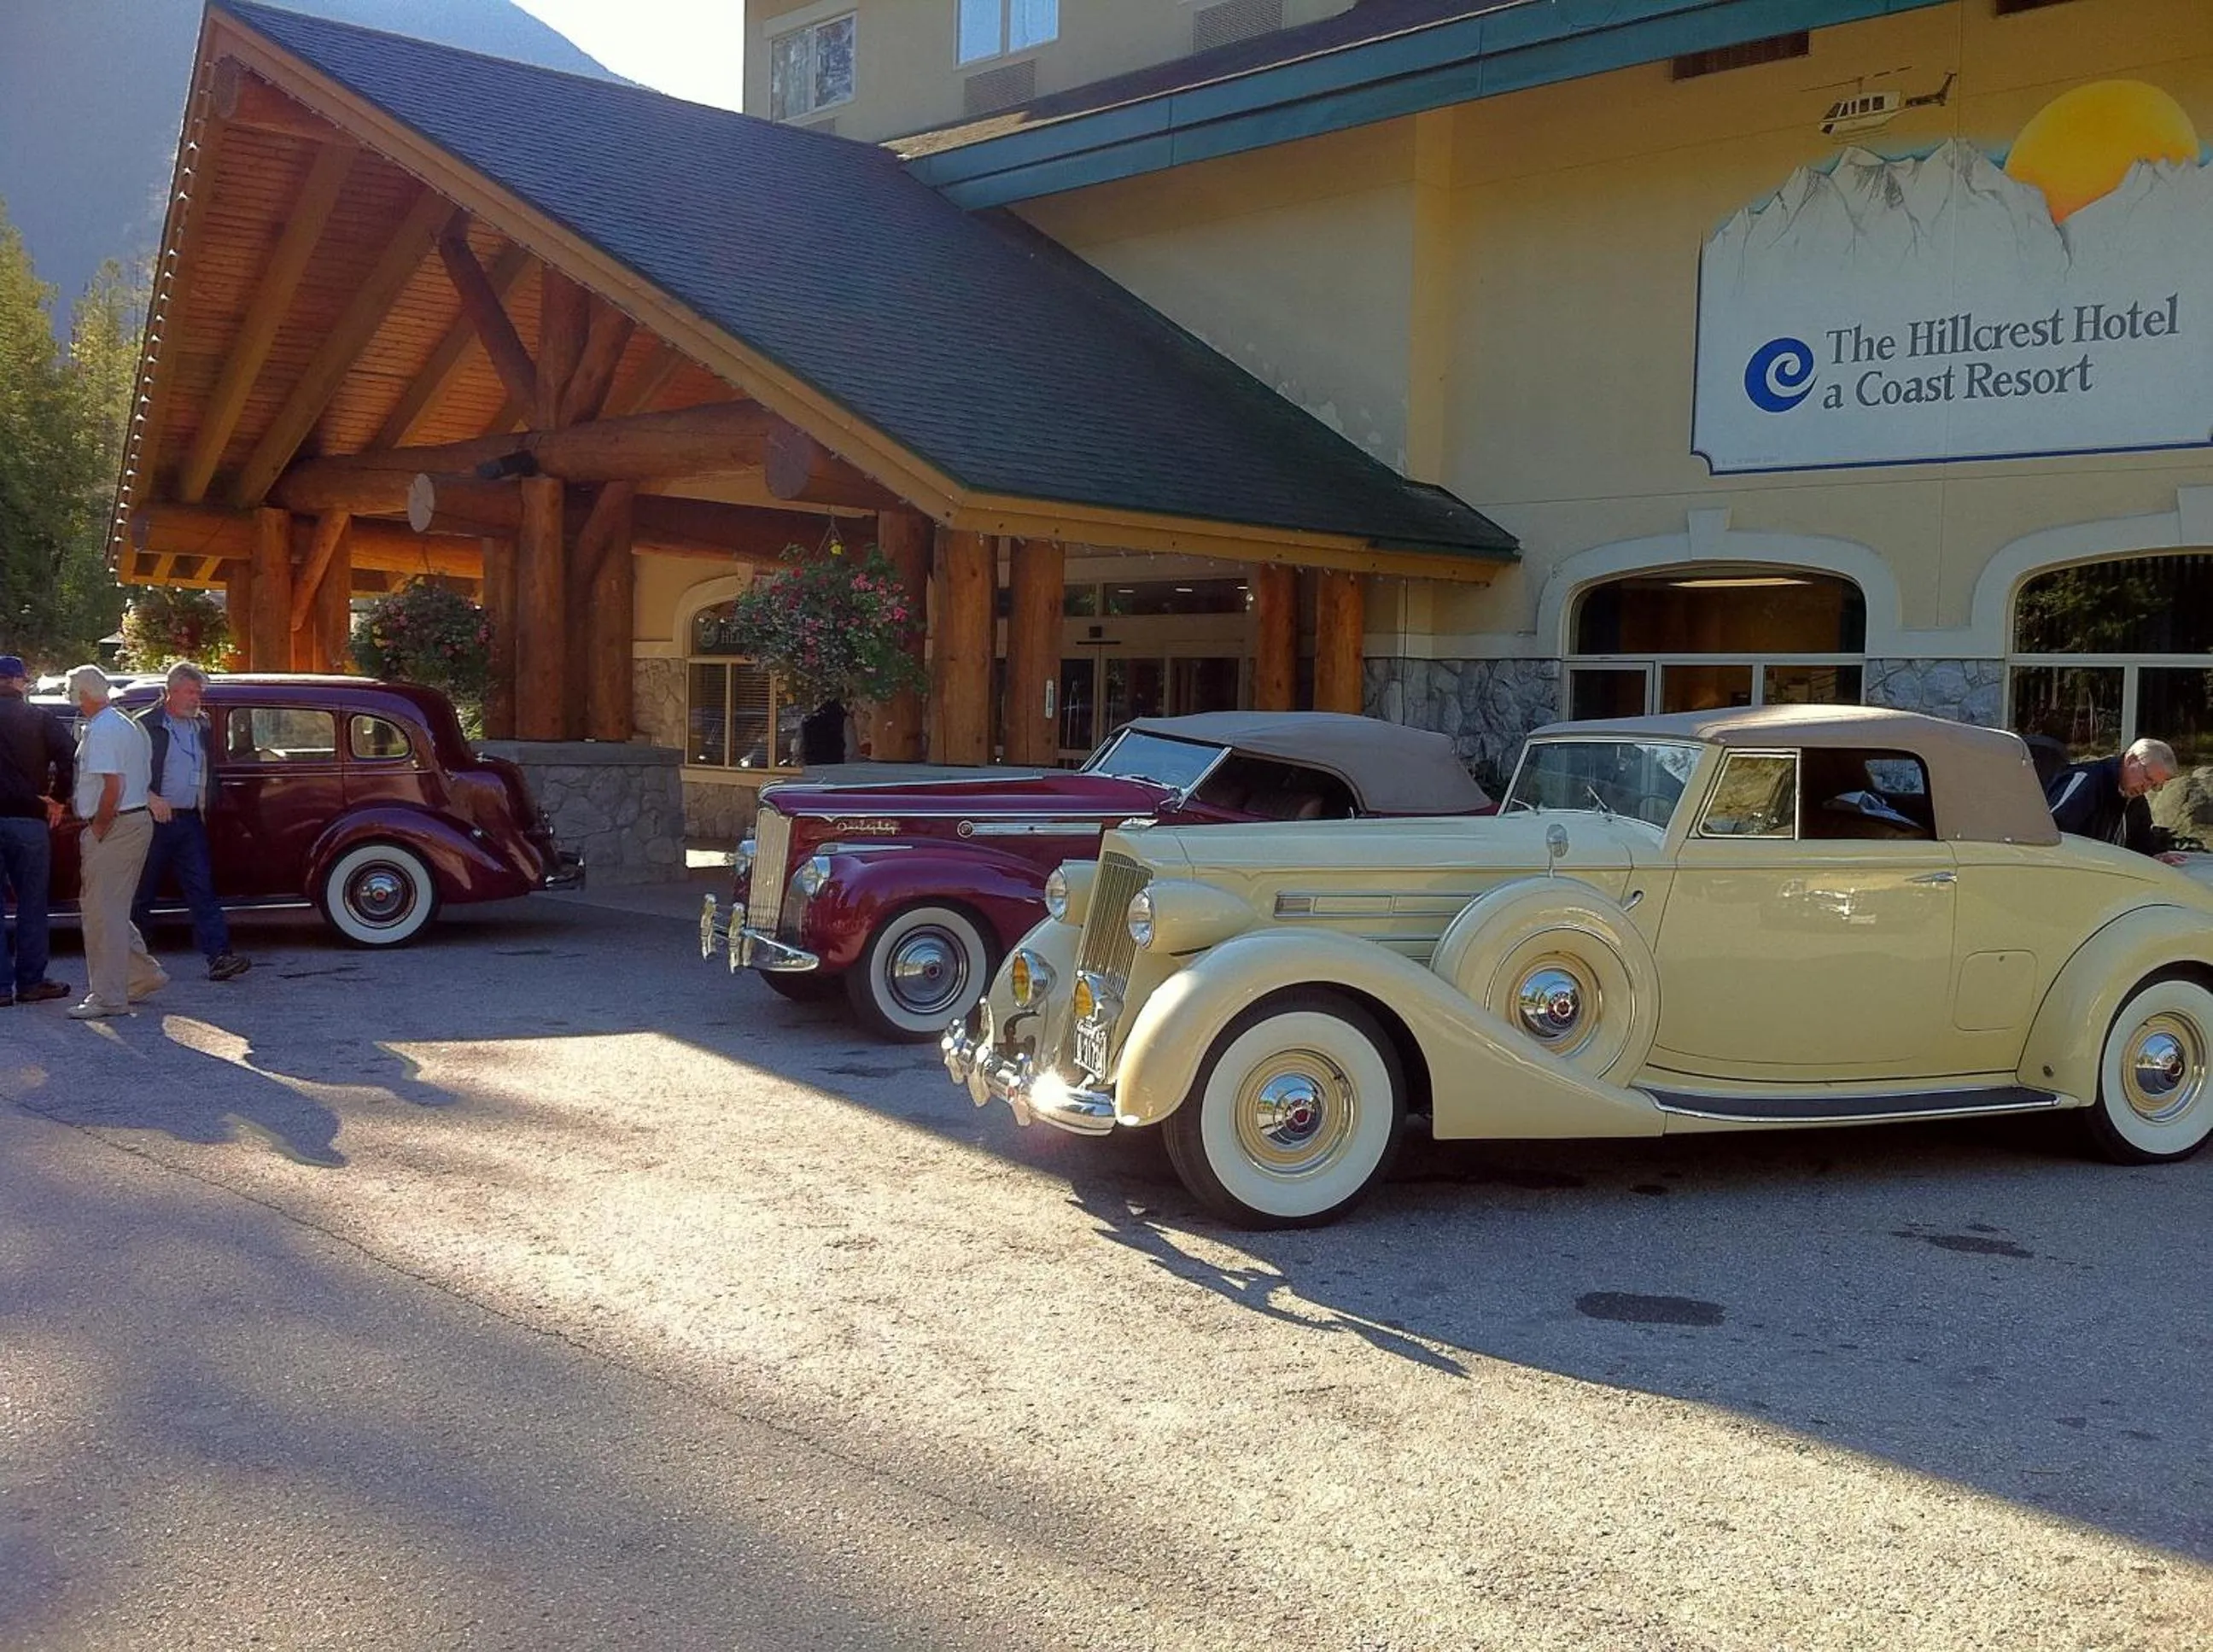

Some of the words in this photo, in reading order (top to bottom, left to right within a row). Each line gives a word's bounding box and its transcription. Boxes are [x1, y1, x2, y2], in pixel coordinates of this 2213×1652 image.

[1825, 323, 1896, 365] The
[1906, 307, 2064, 358] Hillcrest
[2071, 291, 2180, 343] Hotel
[1822, 382, 1845, 410] a
[1855, 365, 1956, 407] Coast
[1963, 353, 2094, 400] Resort
